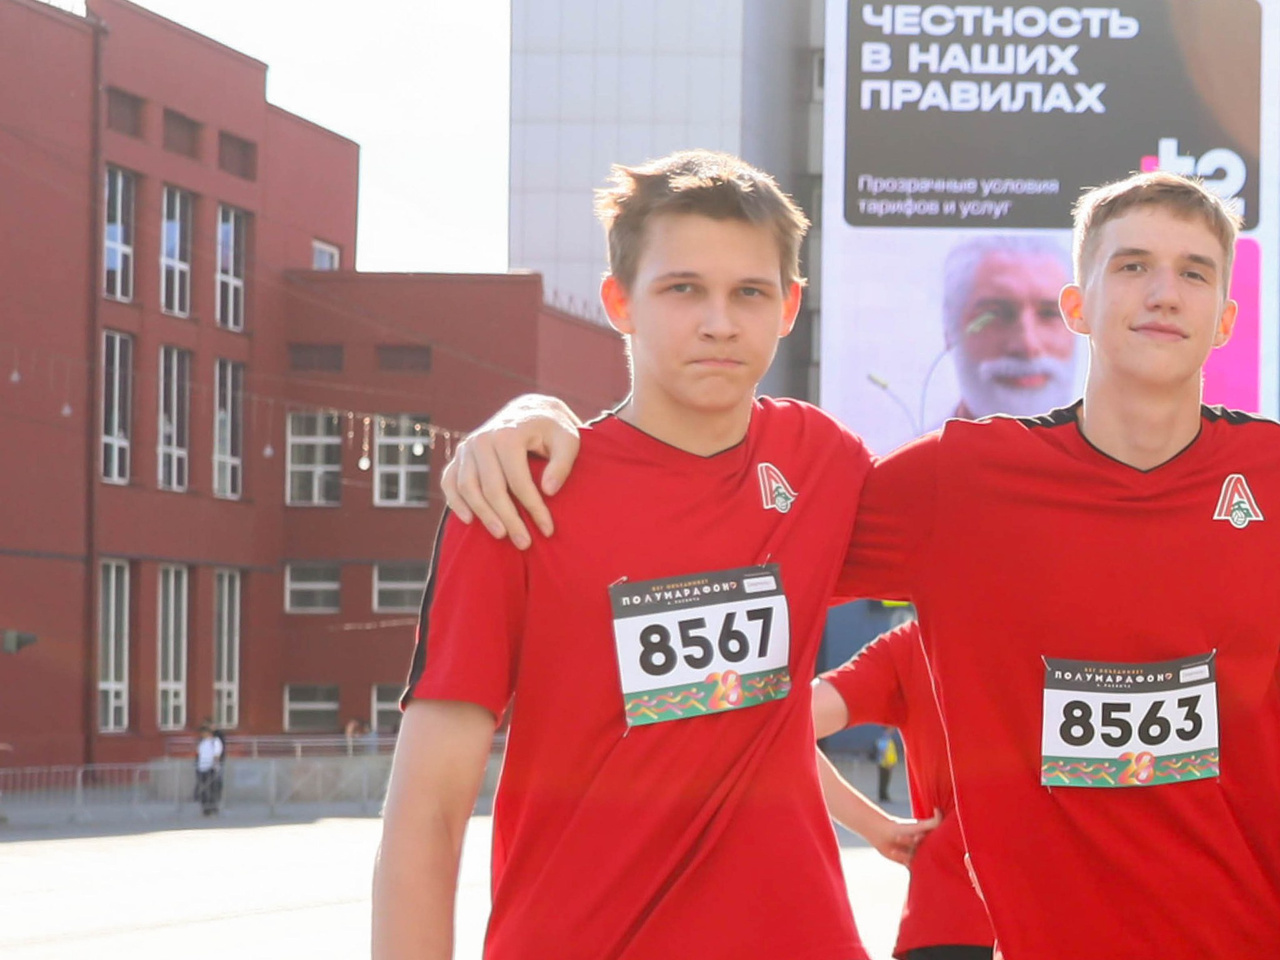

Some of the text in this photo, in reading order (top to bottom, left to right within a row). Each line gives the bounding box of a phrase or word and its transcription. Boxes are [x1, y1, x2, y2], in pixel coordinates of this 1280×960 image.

[862, 6, 1139, 38] ЧЕСТНОСТЬ
[861, 42, 1079, 76] В НАШИХ
[860, 79, 1106, 114] ПРАВИЛАХ
[858, 174, 1060, 198] Прозрачные условия
[858, 195, 1012, 219] тарифов и услуг
[622, 583, 730, 606] ПОЛУМАРАФОН
[639, 606, 774, 676] 8567
[704, 669, 743, 711] 28
[1055, 671, 1165, 684] ПОЛУМАРАФОН
[1059, 694, 1203, 748] 8563
[1117, 751, 1156, 785] 28
